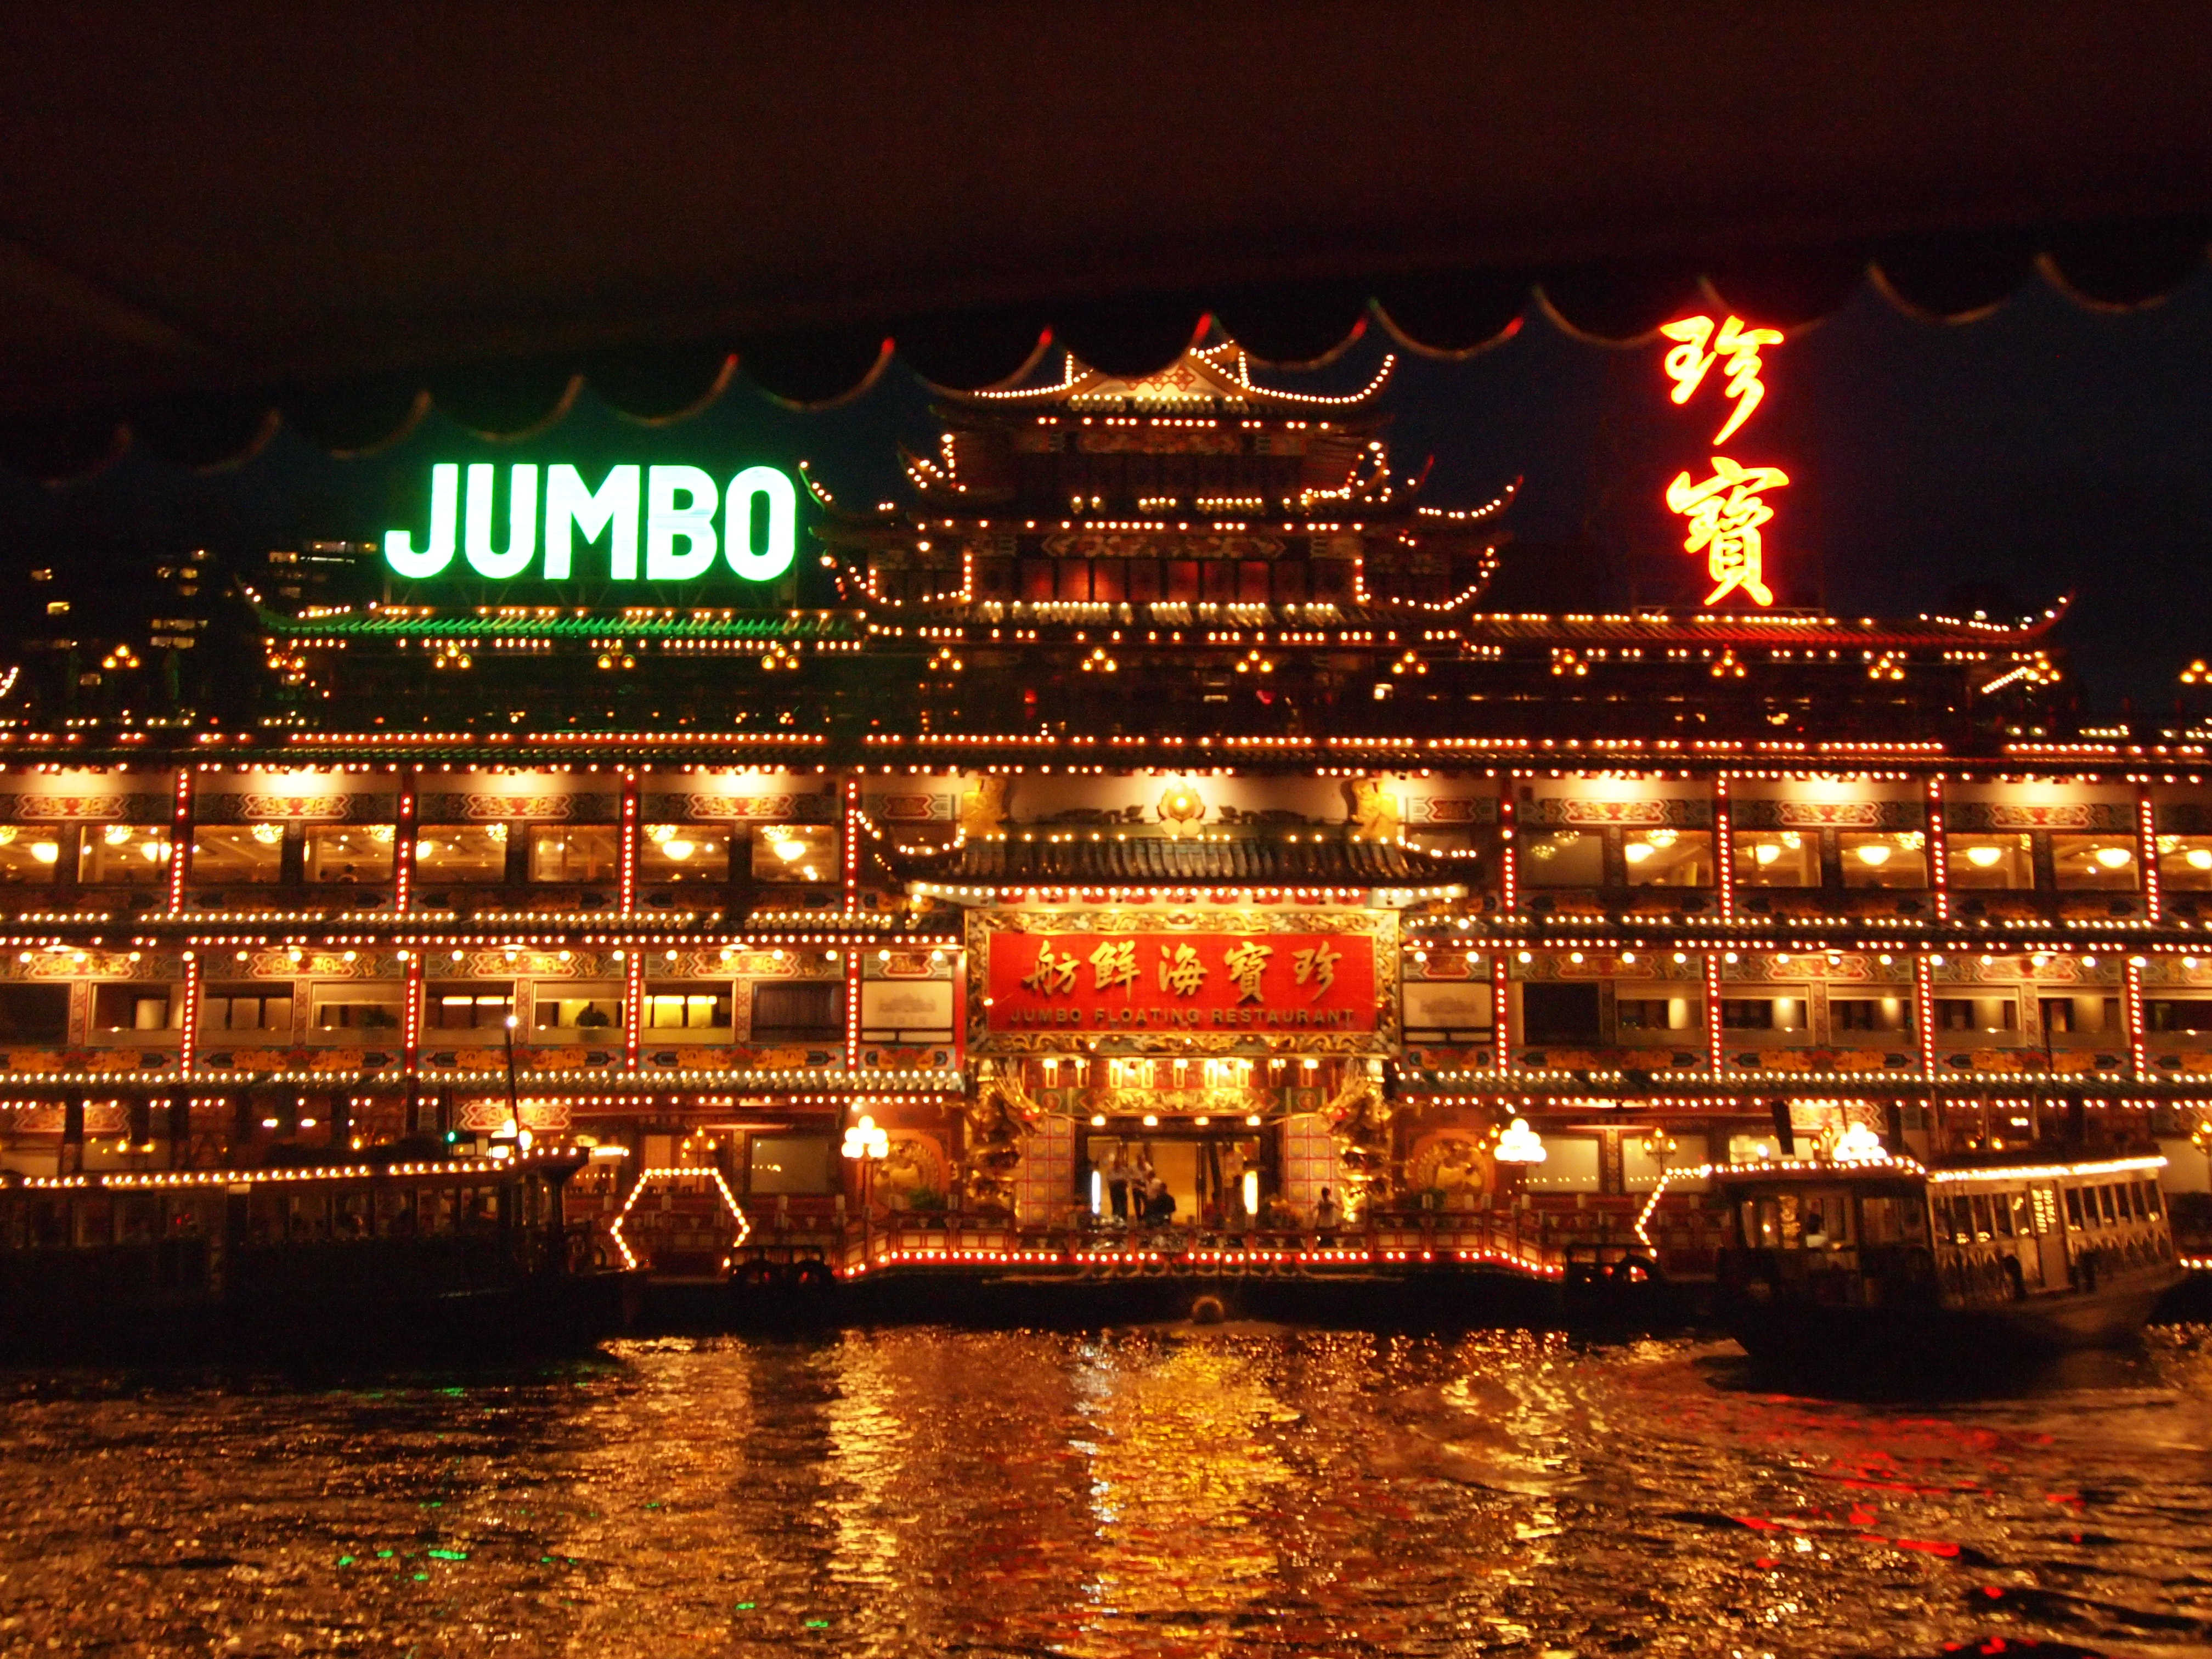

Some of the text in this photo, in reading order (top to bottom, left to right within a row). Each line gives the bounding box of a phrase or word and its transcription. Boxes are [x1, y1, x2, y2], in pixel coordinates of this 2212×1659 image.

[1660, 315, 1789, 606] 珍寶
[385, 464, 795, 581] JUMBO
[1011, 1008, 1353, 1023] JUMBO FLOATING RESTAURANT
